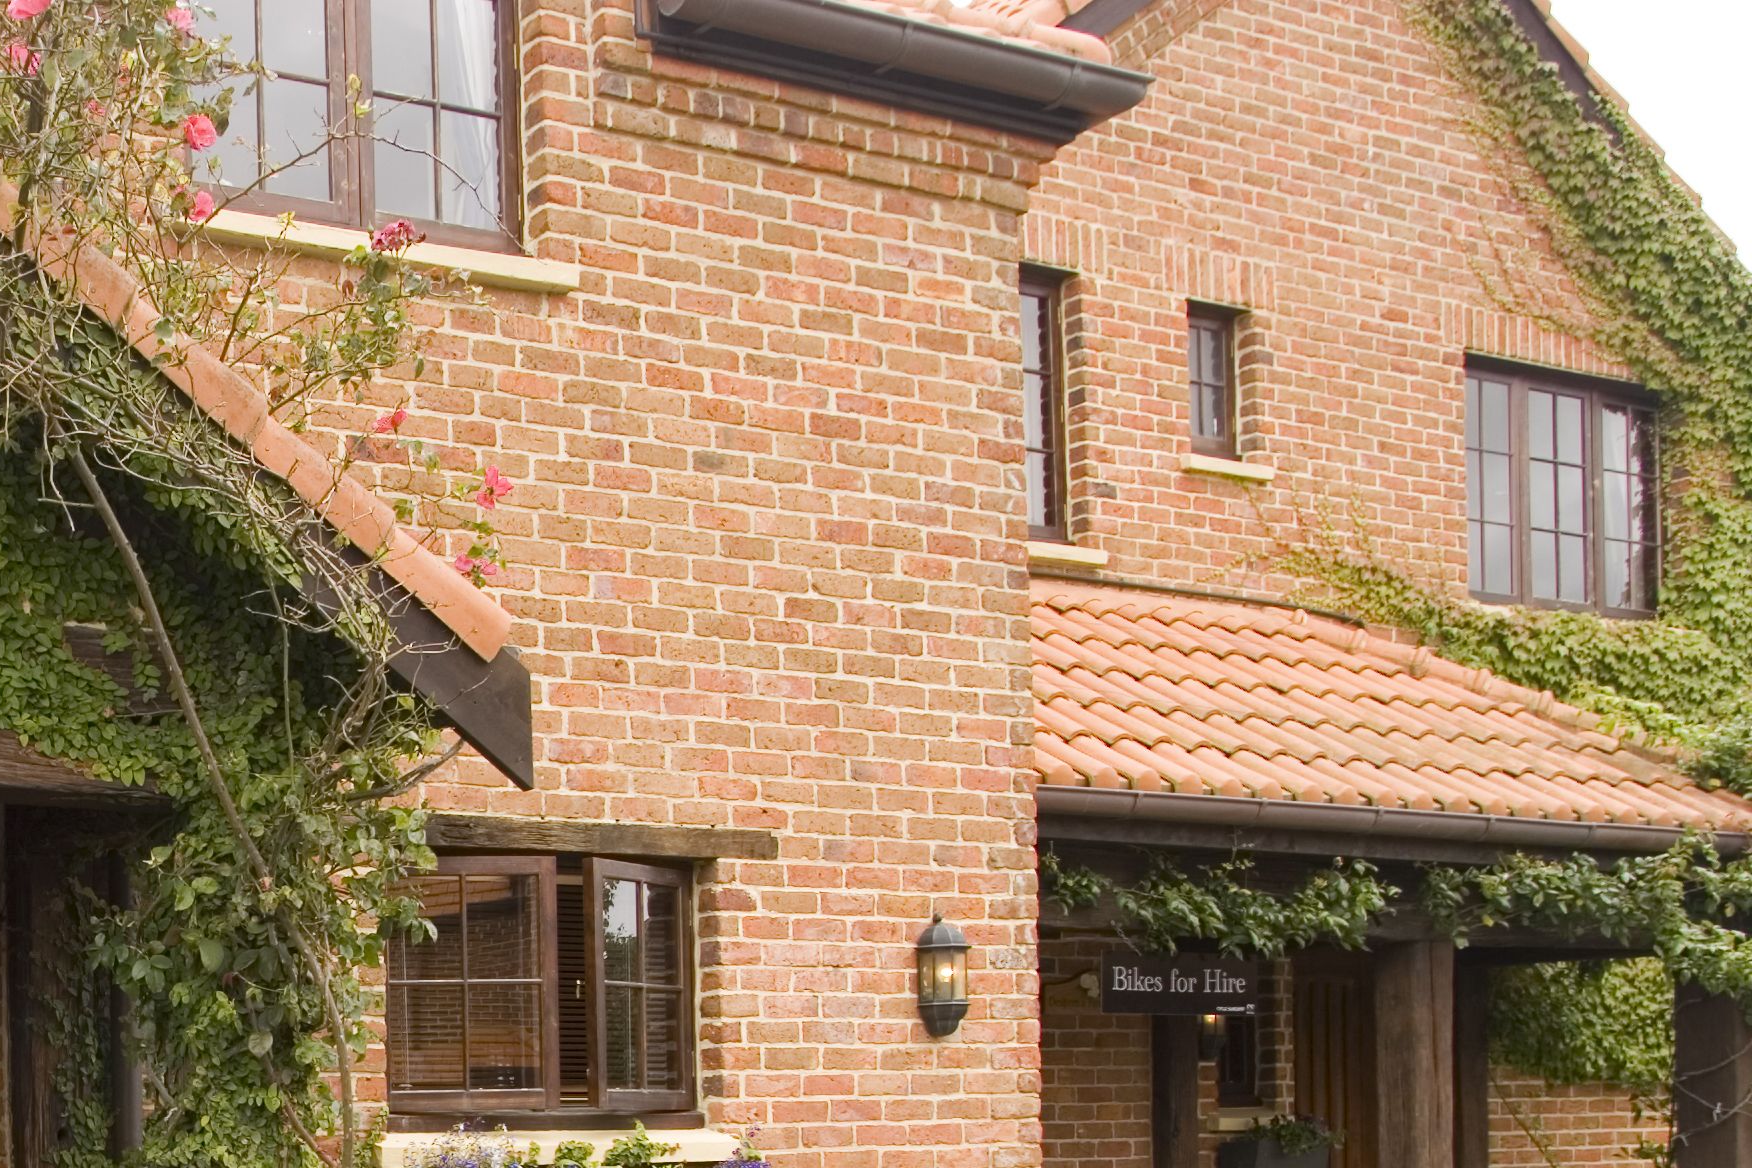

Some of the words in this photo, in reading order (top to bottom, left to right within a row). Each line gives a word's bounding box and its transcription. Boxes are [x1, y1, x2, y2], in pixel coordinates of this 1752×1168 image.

[1112, 966, 1163, 992] Bikes
[1169, 968, 1197, 993] for
[1203, 969, 1246, 994] Hire
